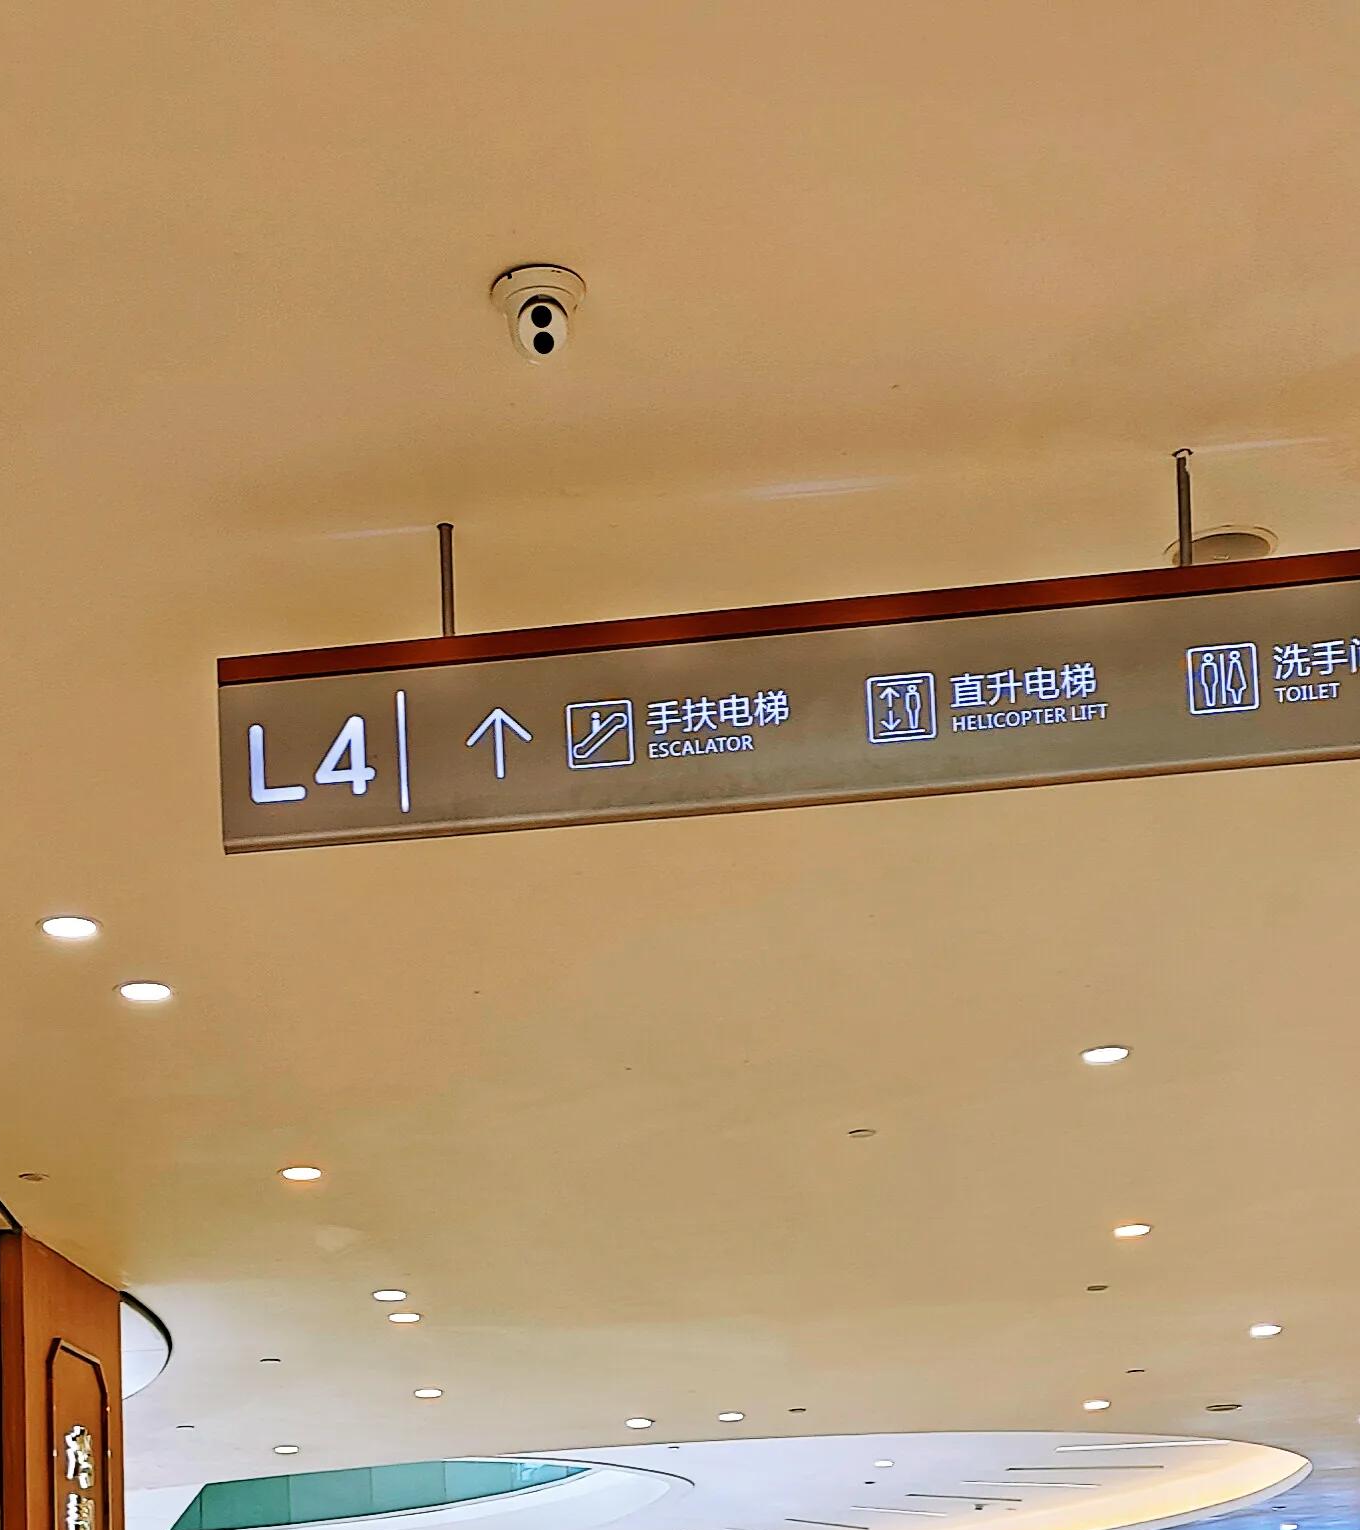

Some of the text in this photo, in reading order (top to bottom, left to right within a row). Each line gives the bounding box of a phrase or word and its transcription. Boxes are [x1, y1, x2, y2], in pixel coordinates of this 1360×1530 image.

[950, 662, 1097, 708] 直升电梯
[1274, 681, 1341, 705] TOILET
[646, 690, 791, 736] 手扶电梯
[951, 701, 1109, 734] HELICOPTER LIFT
[248, 714, 377, 805] L4
[648, 733, 754, 761] ESCALATOR
